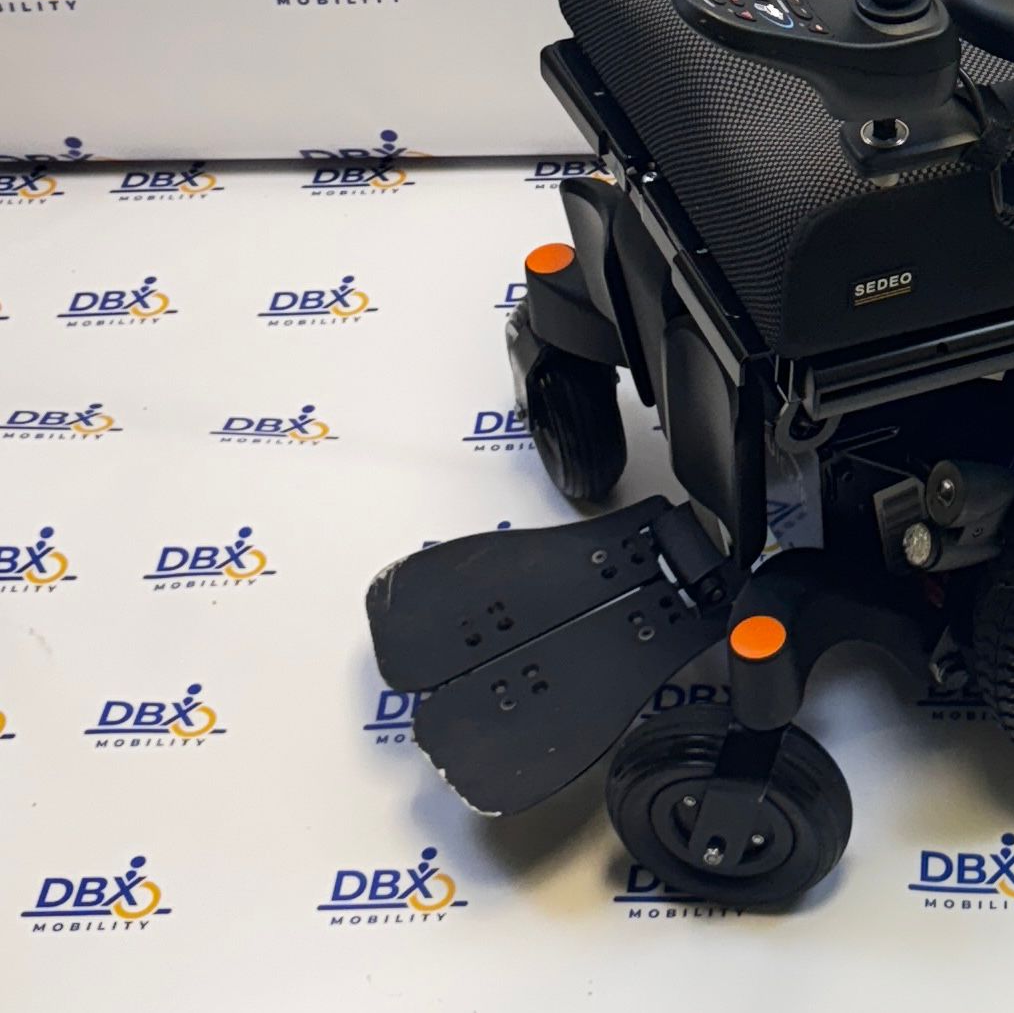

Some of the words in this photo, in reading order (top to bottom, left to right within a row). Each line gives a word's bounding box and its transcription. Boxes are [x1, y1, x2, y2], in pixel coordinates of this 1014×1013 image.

[9, 0, 76, 12] ILITY
[0, 174, 47, 190] BX
[123, 172, 202, 188] DBX
[312, 165, 389, 183] DBX
[855, 272, 912, 297] SEDEO
[69, 289, 158, 312] DBX
[269, 290, 355, 311] DBX
[67, 318, 159, 327] MOBILITY
[268, 317, 360, 326] MOBILITY
[7, 411, 99, 426] DBX
[222, 417, 315, 434] DBX
[0, 546, 55, 573] BX
[156, 546, 254, 572] DBX
[154, 579, 256, 591] MOBILITY
[98, 701, 199, 727] DBX
[96, 739, 205, 748] MOBILITY
[35, 877, 146, 908] DBX
[331, 869, 438, 901] DBX
[33, 921, 149, 932] MOBILITY
[330, 913, 446, 925] MOBILITY
